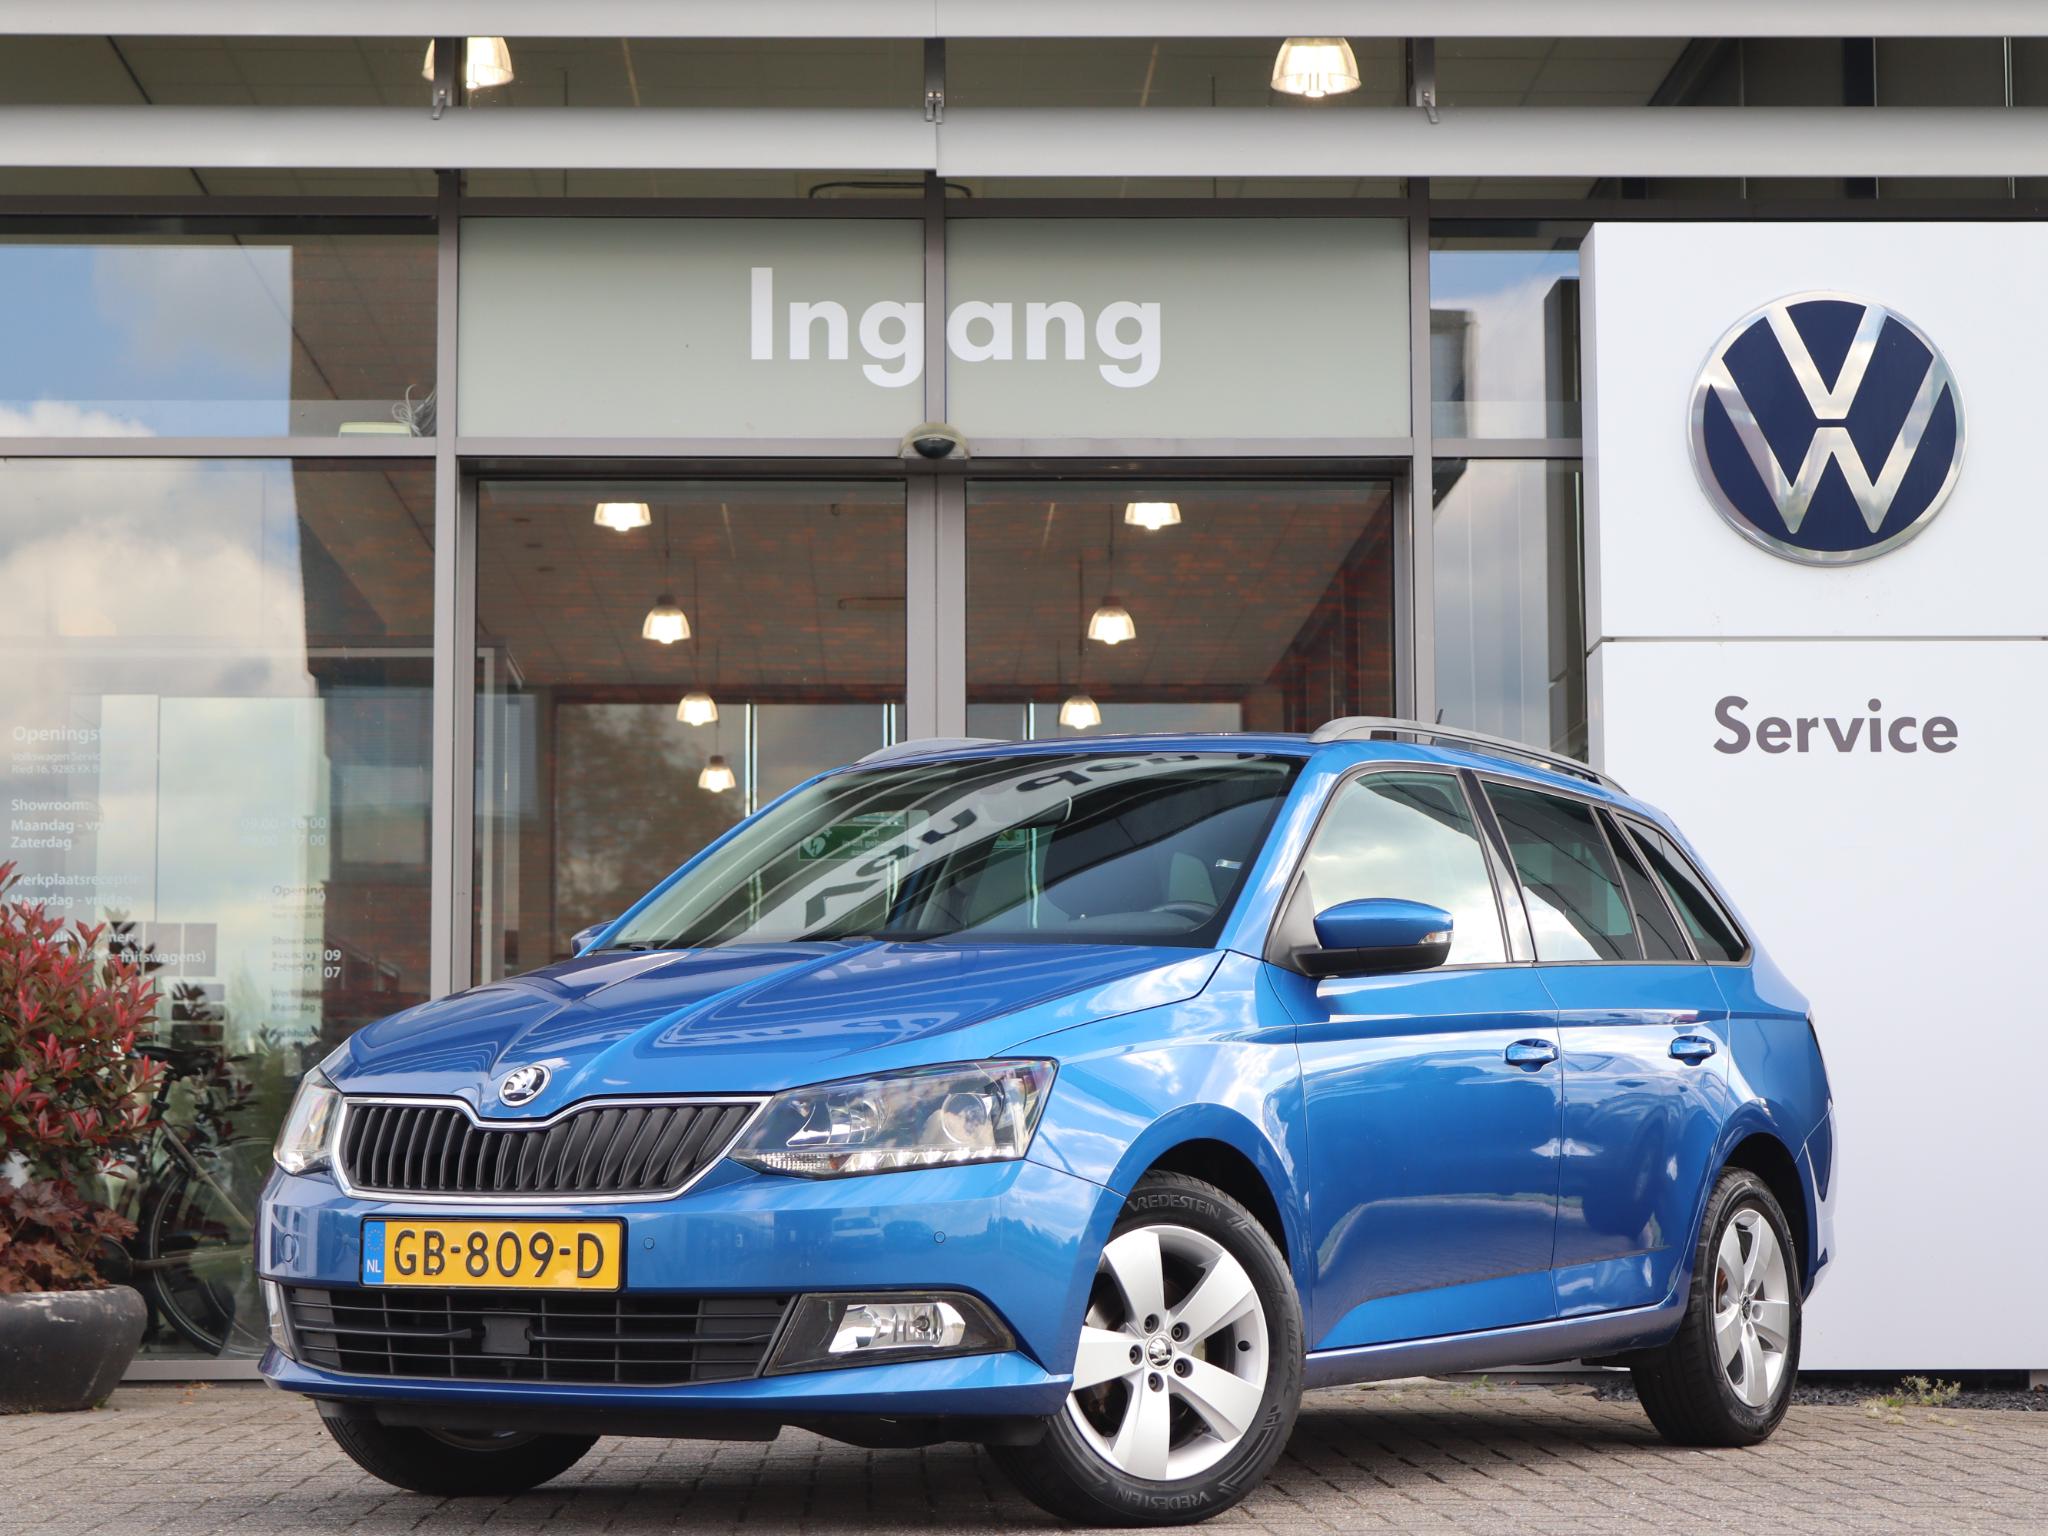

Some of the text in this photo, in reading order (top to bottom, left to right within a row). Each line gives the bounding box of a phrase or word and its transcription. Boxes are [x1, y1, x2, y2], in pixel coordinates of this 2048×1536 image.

[751, 267, 1161, 388] Ingang
[1714, 695, 1958, 754] Service
[11, 799, 89, 811] Showroom:
[11, 820, 74, 834] Maandag
[11, 836, 72, 851] Zaterdag
[1126, 1193, 1222, 1218] VREDESTEIN
[366, 1229, 605, 1279] NL GB-809-D
[1113, 1486, 1211, 1510] VREDESTEIN
